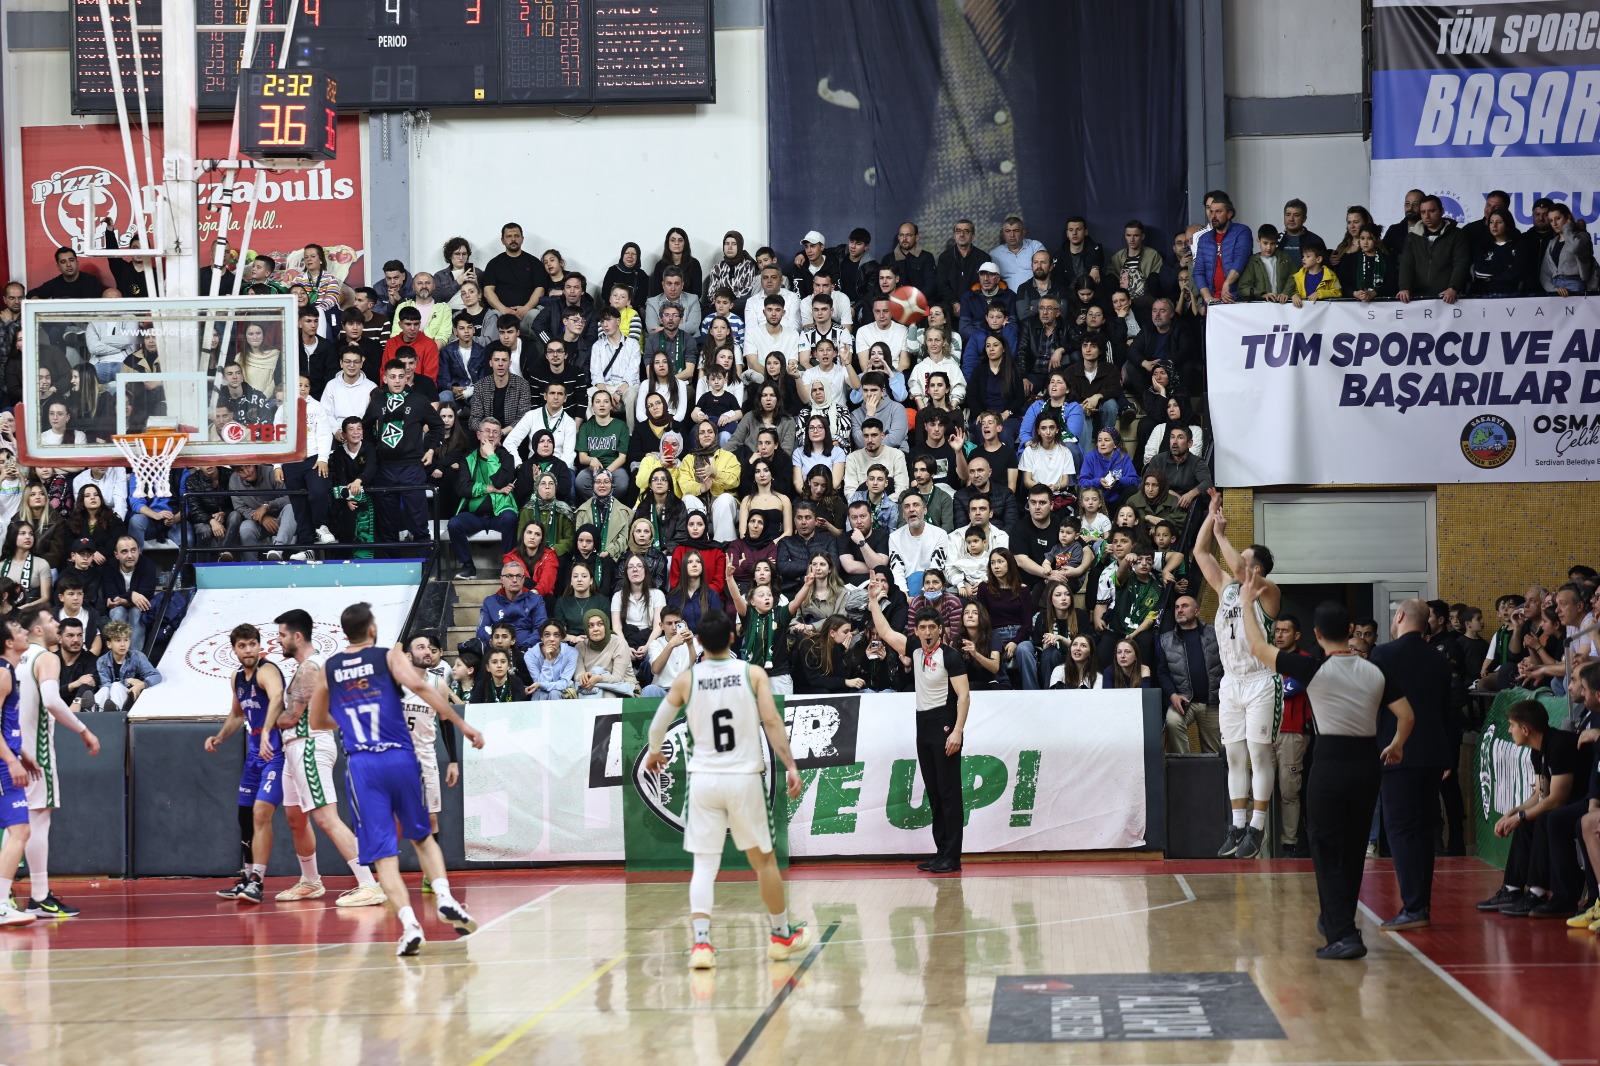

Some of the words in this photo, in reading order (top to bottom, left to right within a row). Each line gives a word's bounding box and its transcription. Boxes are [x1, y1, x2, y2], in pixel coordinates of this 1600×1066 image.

[519, 5, 530, 21] 2
[541, 4, 555, 20] 10
[541, 21, 555, 37] 10
[559, 21, 579, 37] 22
[1436, 8, 1496, 55] TÜM
[1501, 11, 1600, 54] SPORC
[378, 35, 407, 48] PERIOD
[263, 74, 313, 96] 2:32
[1414, 70, 1600, 158] BAŞAR
[31, 171, 112, 204] pizza
[142, 168, 354, 214] pzzabulls
[1240, 325, 1322, 370] TÜM
[1330, 331, 1490, 368] SPORCU
[1501, 330, 1554, 365] VE
[1339, 370, 1572, 415] BAŞARILAR
[246, 423, 287, 443] TBF
[1556, 426, 1600, 458] Çelik
[1535, 459, 1565, 467] Serdivan
[1566, 458, 1595, 467] Belediye
[1229, 623, 1236, 640] 1
[334, 663, 374, 683] ÖZVER
[698, 677, 722, 691] MURAT
[344, 703, 380, 743] 17
[712, 708, 736, 753] 6
[886, 750, 1042, 830] UP!
